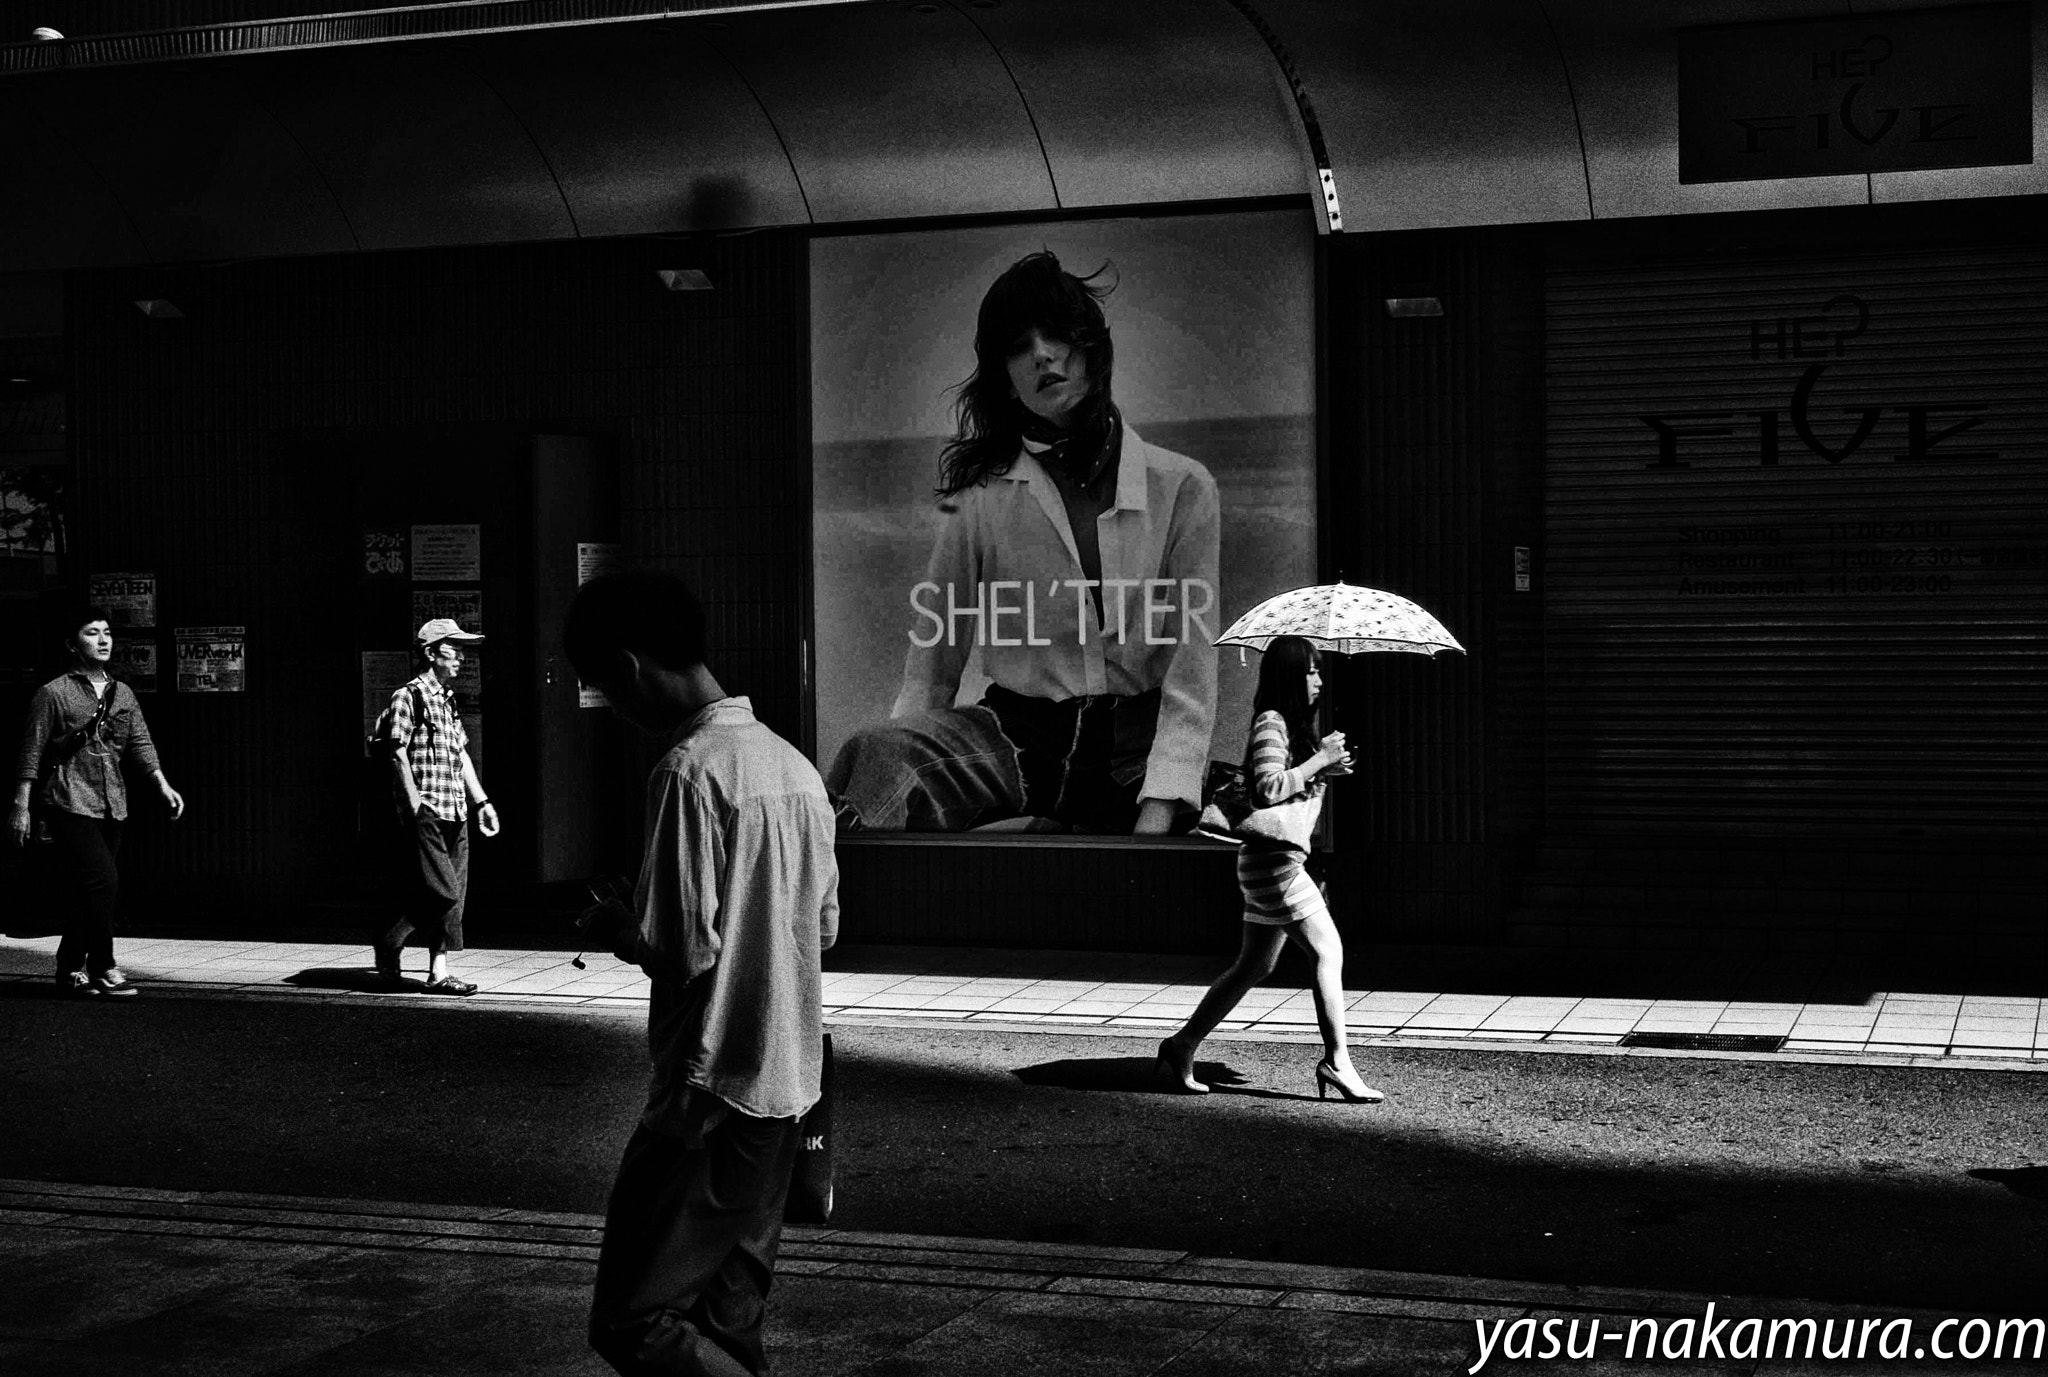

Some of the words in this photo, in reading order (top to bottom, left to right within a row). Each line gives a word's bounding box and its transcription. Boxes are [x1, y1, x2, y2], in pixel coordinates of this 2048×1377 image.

[1731, 82, 1978, 153] FIVE
[1638, 364, 1999, 468] FIVE
[1679, 526, 1781, 547] Shopping
[1829, 521, 1950, 540] 11:00-21:00
[1679, 551, 1795, 570] Restaurant
[1829, 547, 1950, 567] 11:00-22:30
[91, 580, 154, 597] SEVENTEEN
[1678, 577, 1805, 595] Amusement
[1829, 574, 1950, 593] 11:00-23:00
[178, 643, 243, 660] UVERworld
